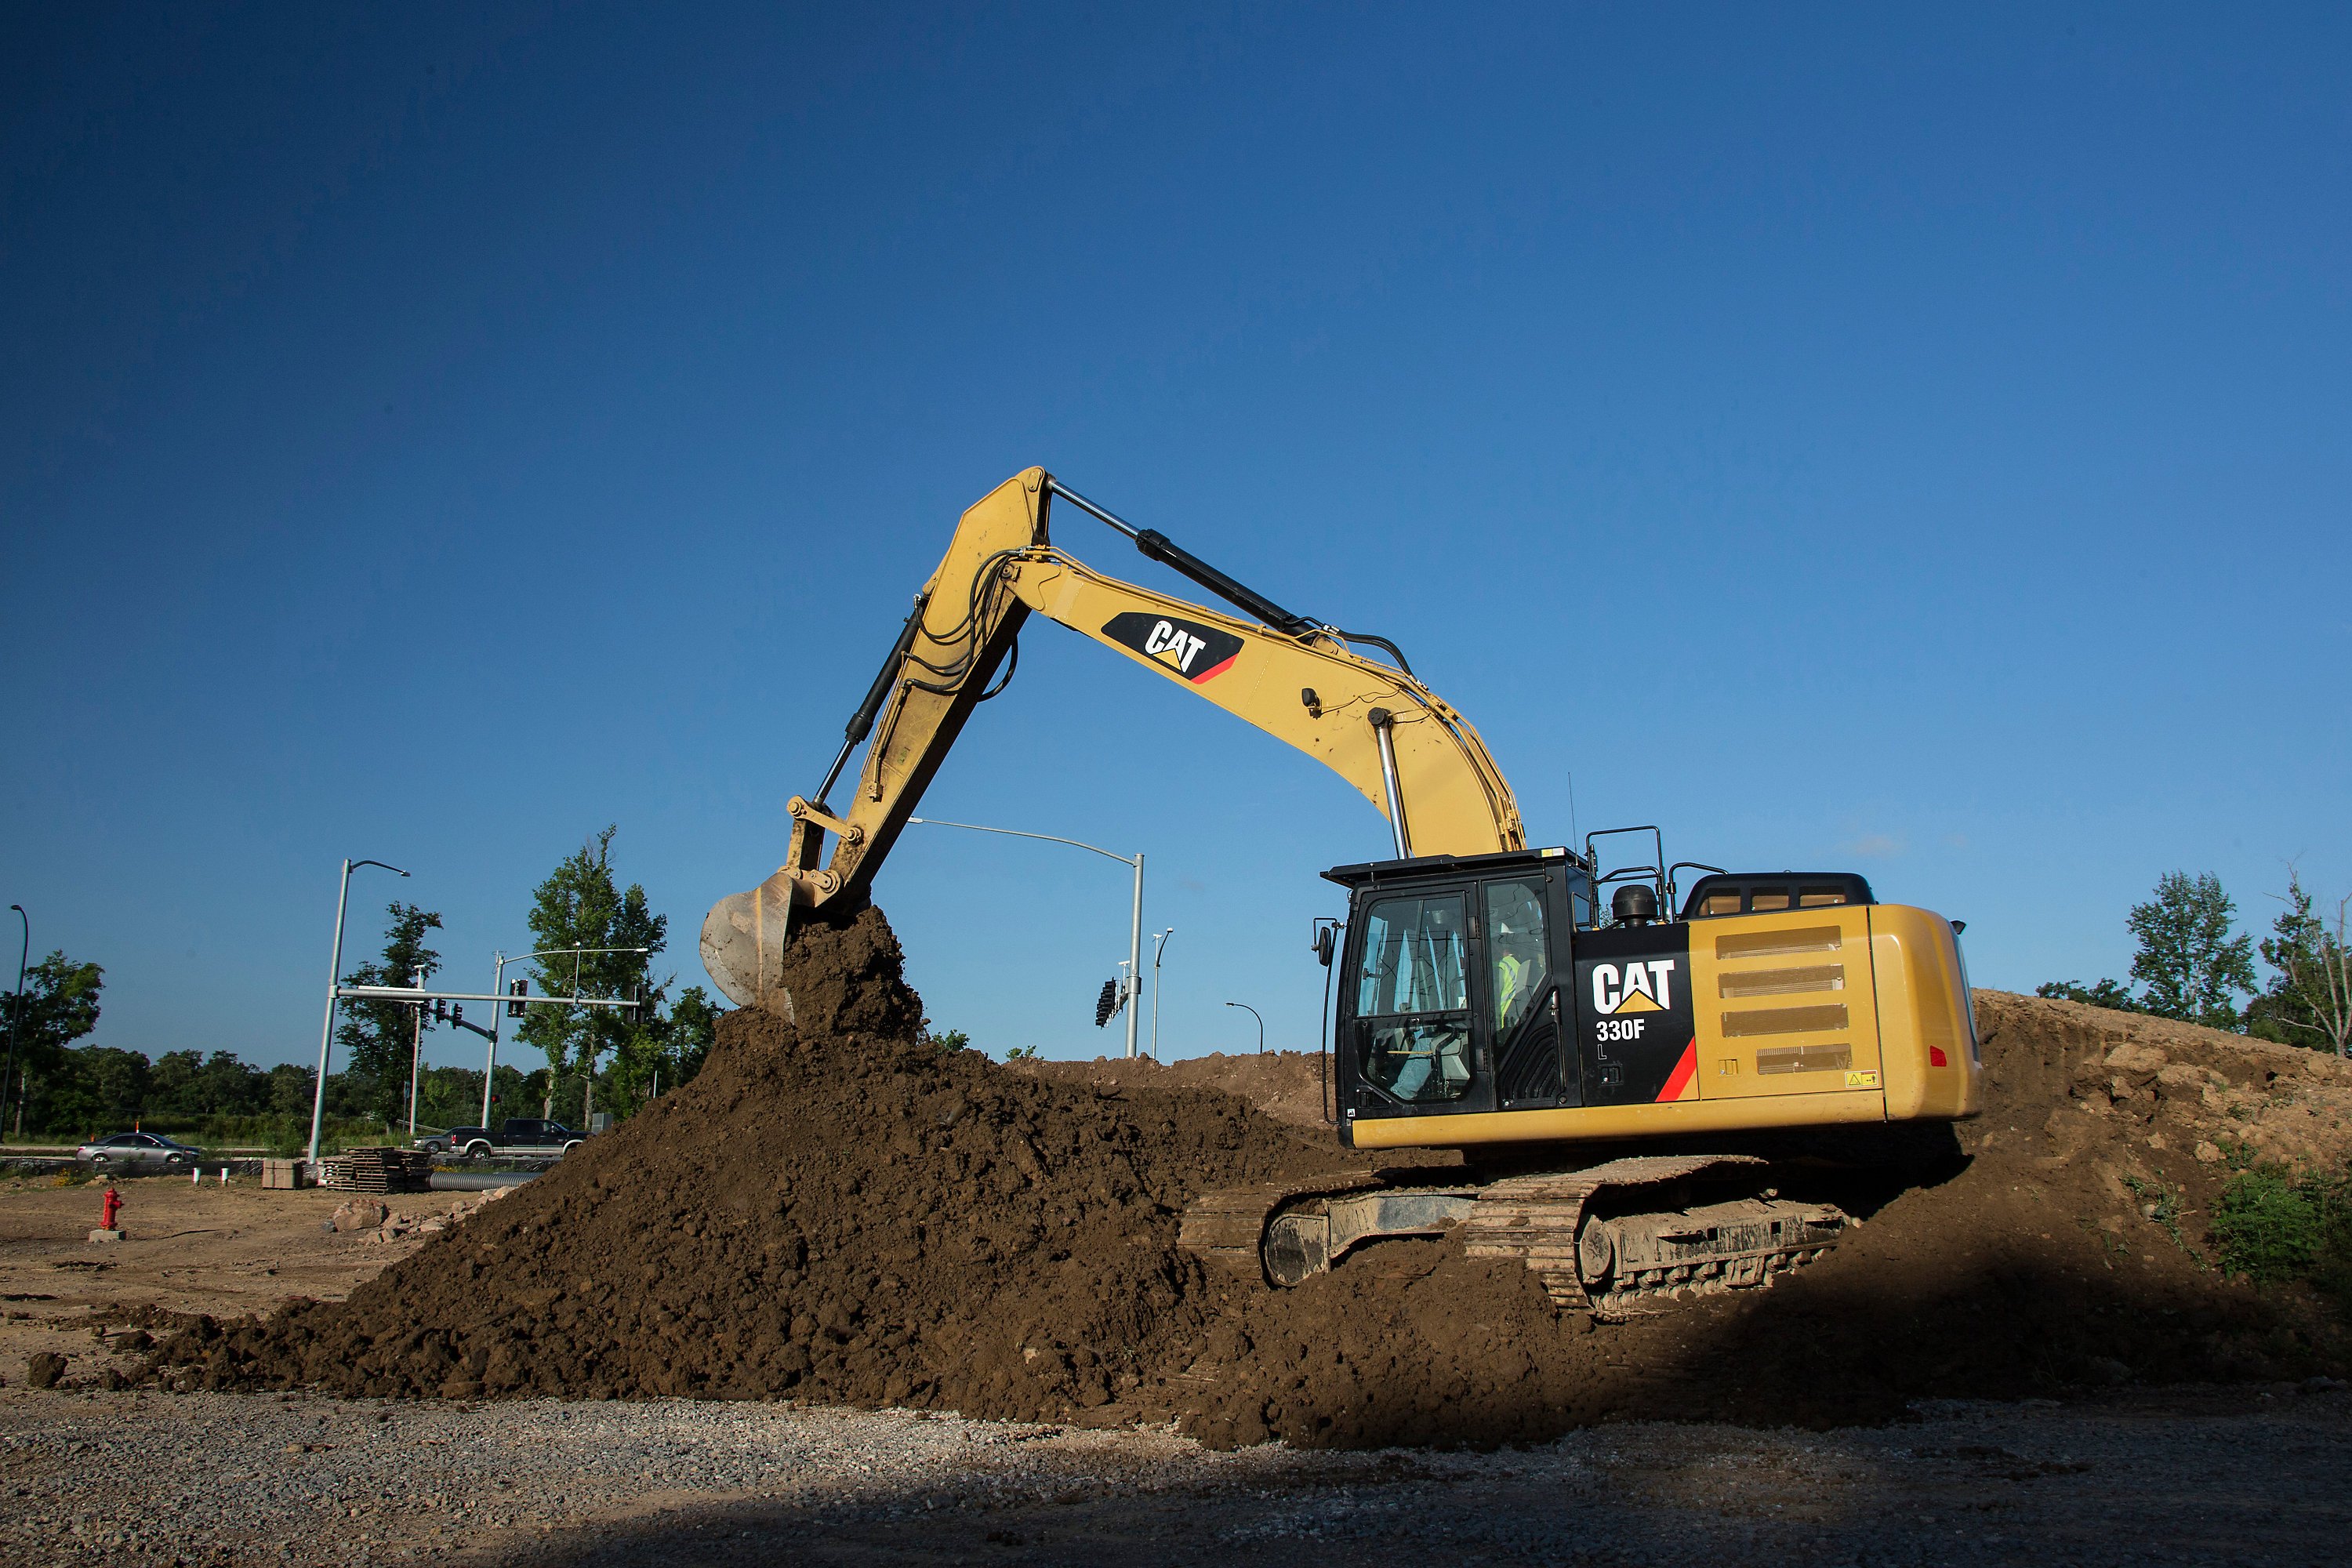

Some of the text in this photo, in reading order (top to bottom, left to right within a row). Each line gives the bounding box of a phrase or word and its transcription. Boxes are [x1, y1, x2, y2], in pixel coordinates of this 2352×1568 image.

[1145, 620, 1207, 673] CAT
[1592, 960, 1675, 1014] CAT
[1596, 1018, 1645, 1042] 330F
[1597, 1044, 1607, 1060] L
